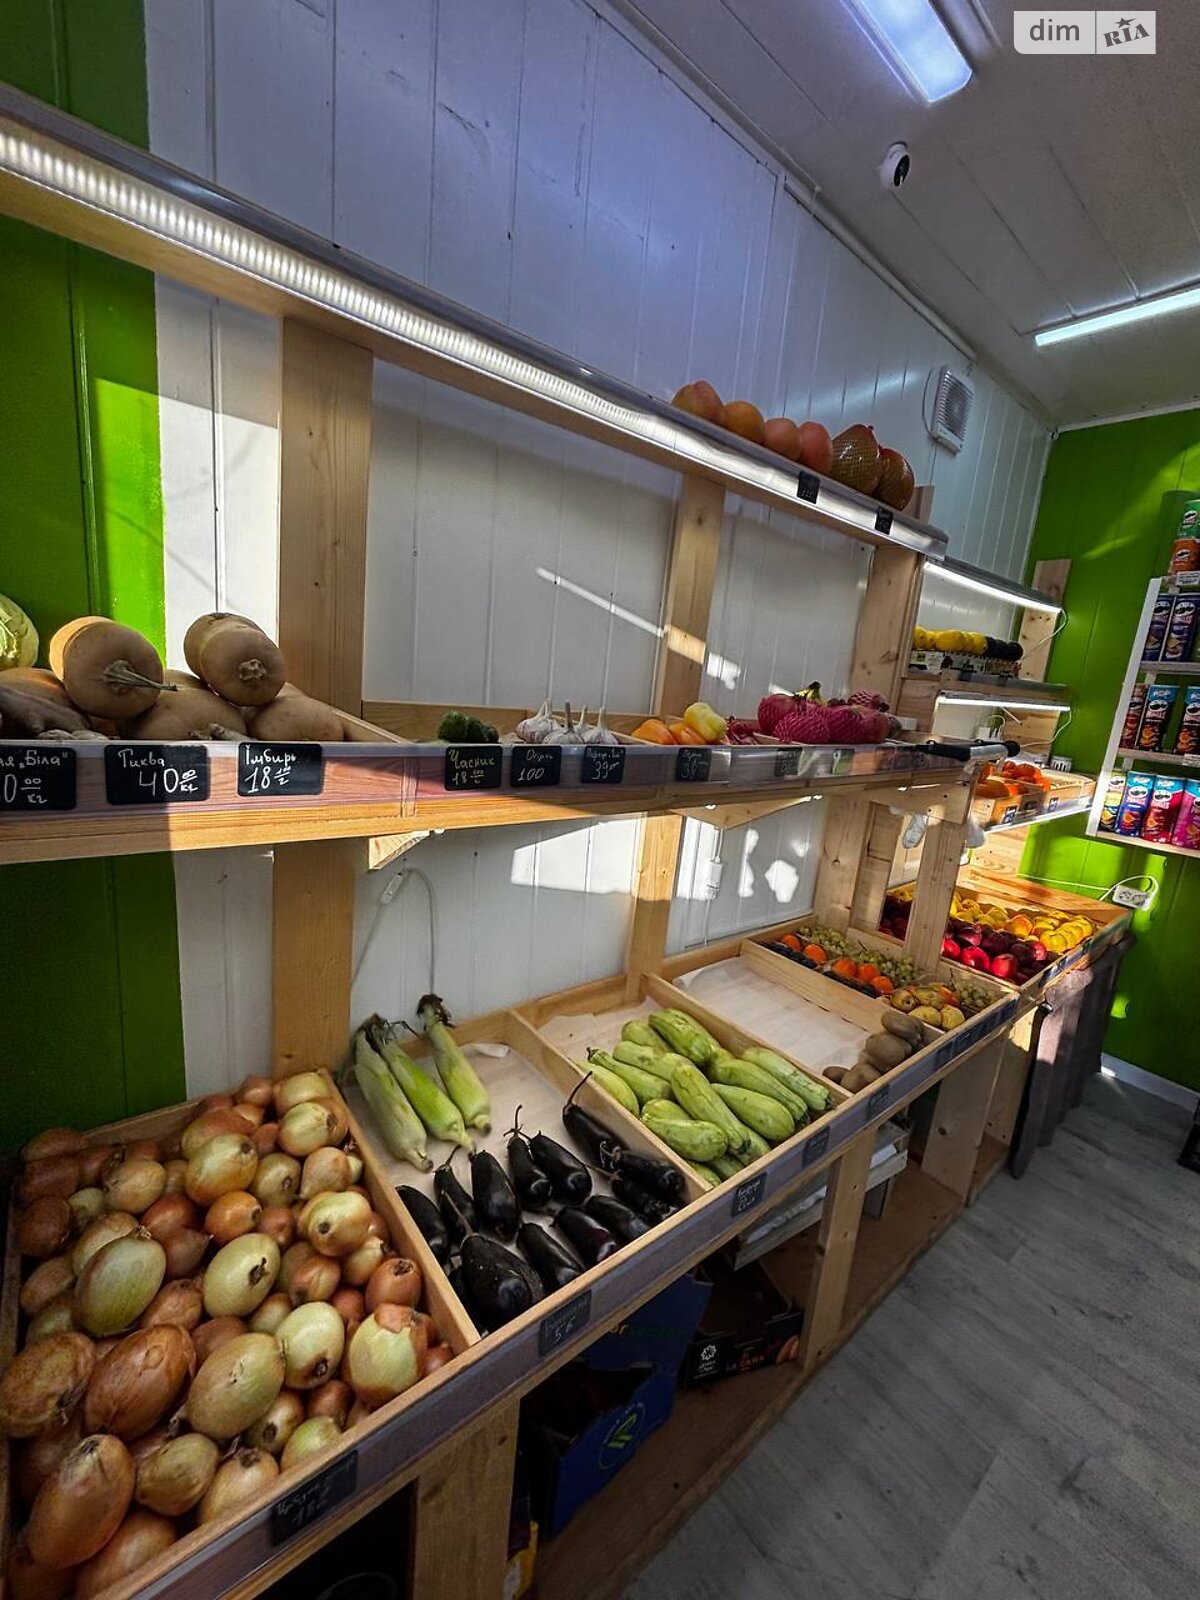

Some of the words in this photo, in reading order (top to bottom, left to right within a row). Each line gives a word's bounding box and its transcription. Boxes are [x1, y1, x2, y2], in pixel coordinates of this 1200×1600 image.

[138, 767, 180, 798] 40
[244, 765, 272, 794] 18
[516, 767, 545, 781] 100
